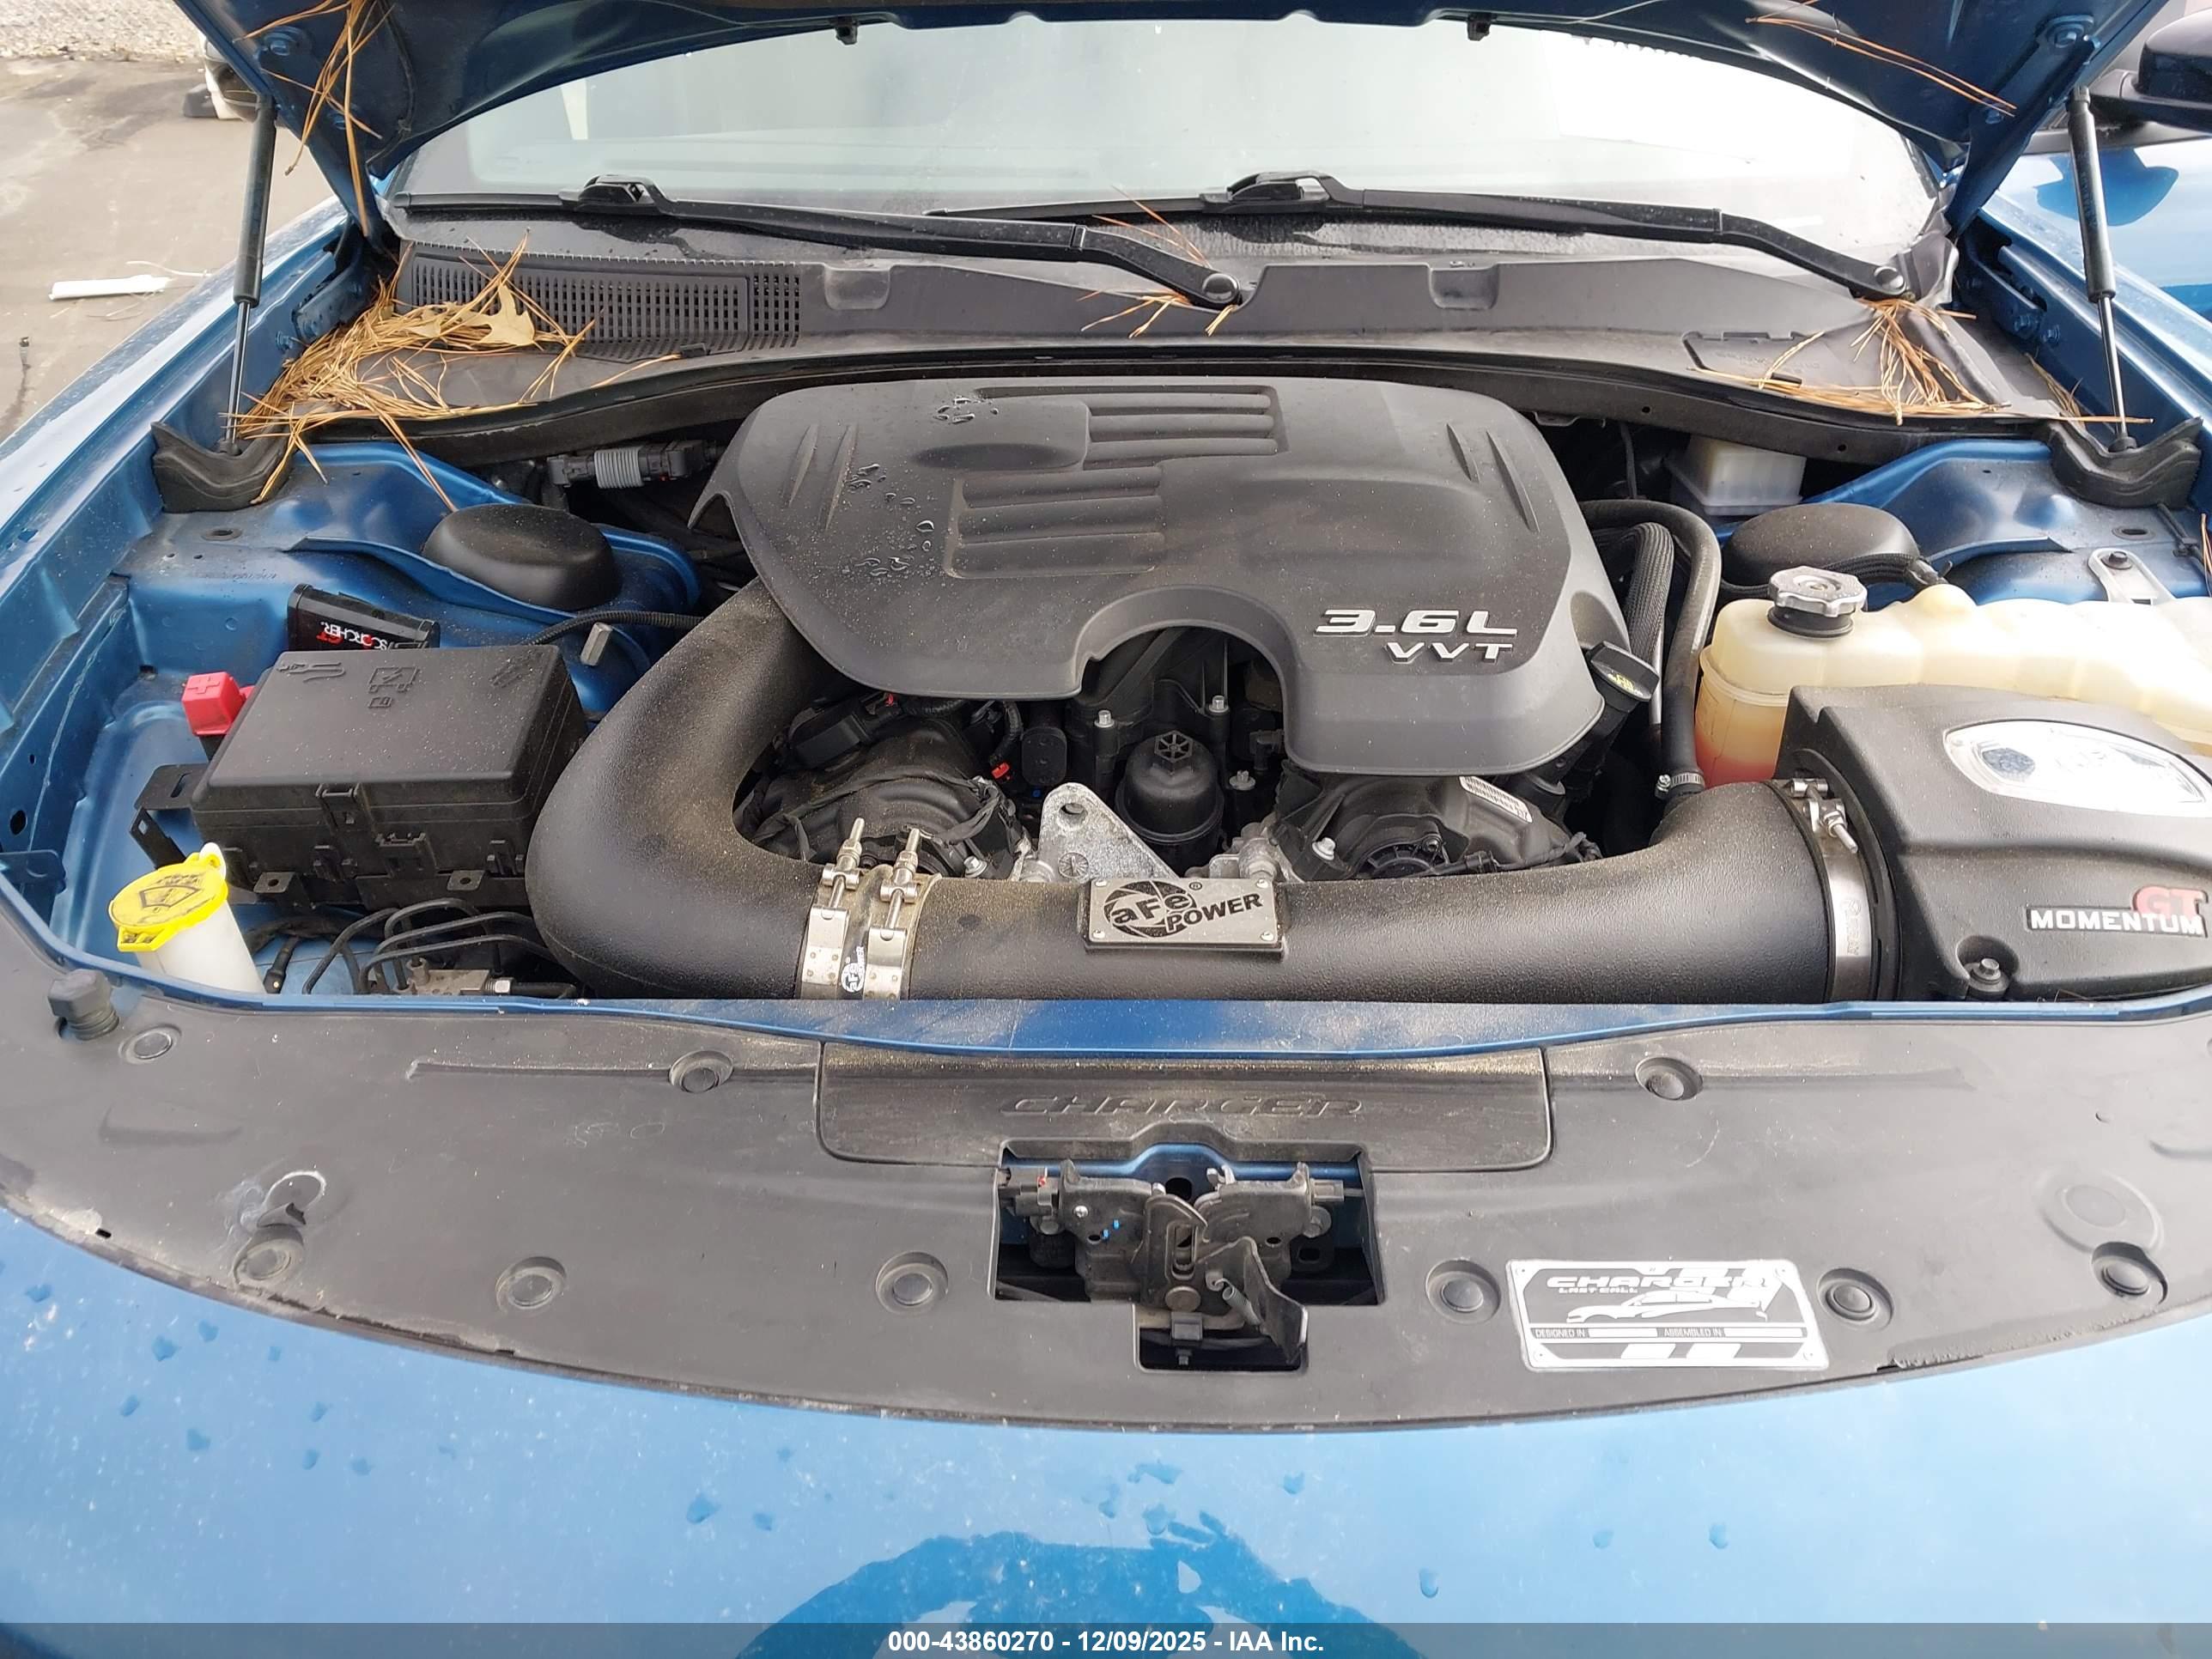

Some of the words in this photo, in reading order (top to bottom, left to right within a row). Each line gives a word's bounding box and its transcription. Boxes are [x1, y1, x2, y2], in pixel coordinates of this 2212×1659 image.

[1314, 610, 1518, 635] 3.6L
[324, 622, 389, 650] SCORCHER
[1383, 642, 1513, 662] VVT
[1110, 892, 1192, 925] aFe
[1166, 893, 1264, 933] POWER
[2136, 885, 2206, 920] GT
[2030, 909, 2204, 936] MOMENTUM
[1000, 1093, 1365, 1116] CHARGER
[1535, 1328, 1575, 1338] DESIGNED
[1576, 1328, 1586, 1338] IN
[1663, 1328, 1711, 1338] ASSEMBLED
[1712, 1328, 1723, 1338] IN
